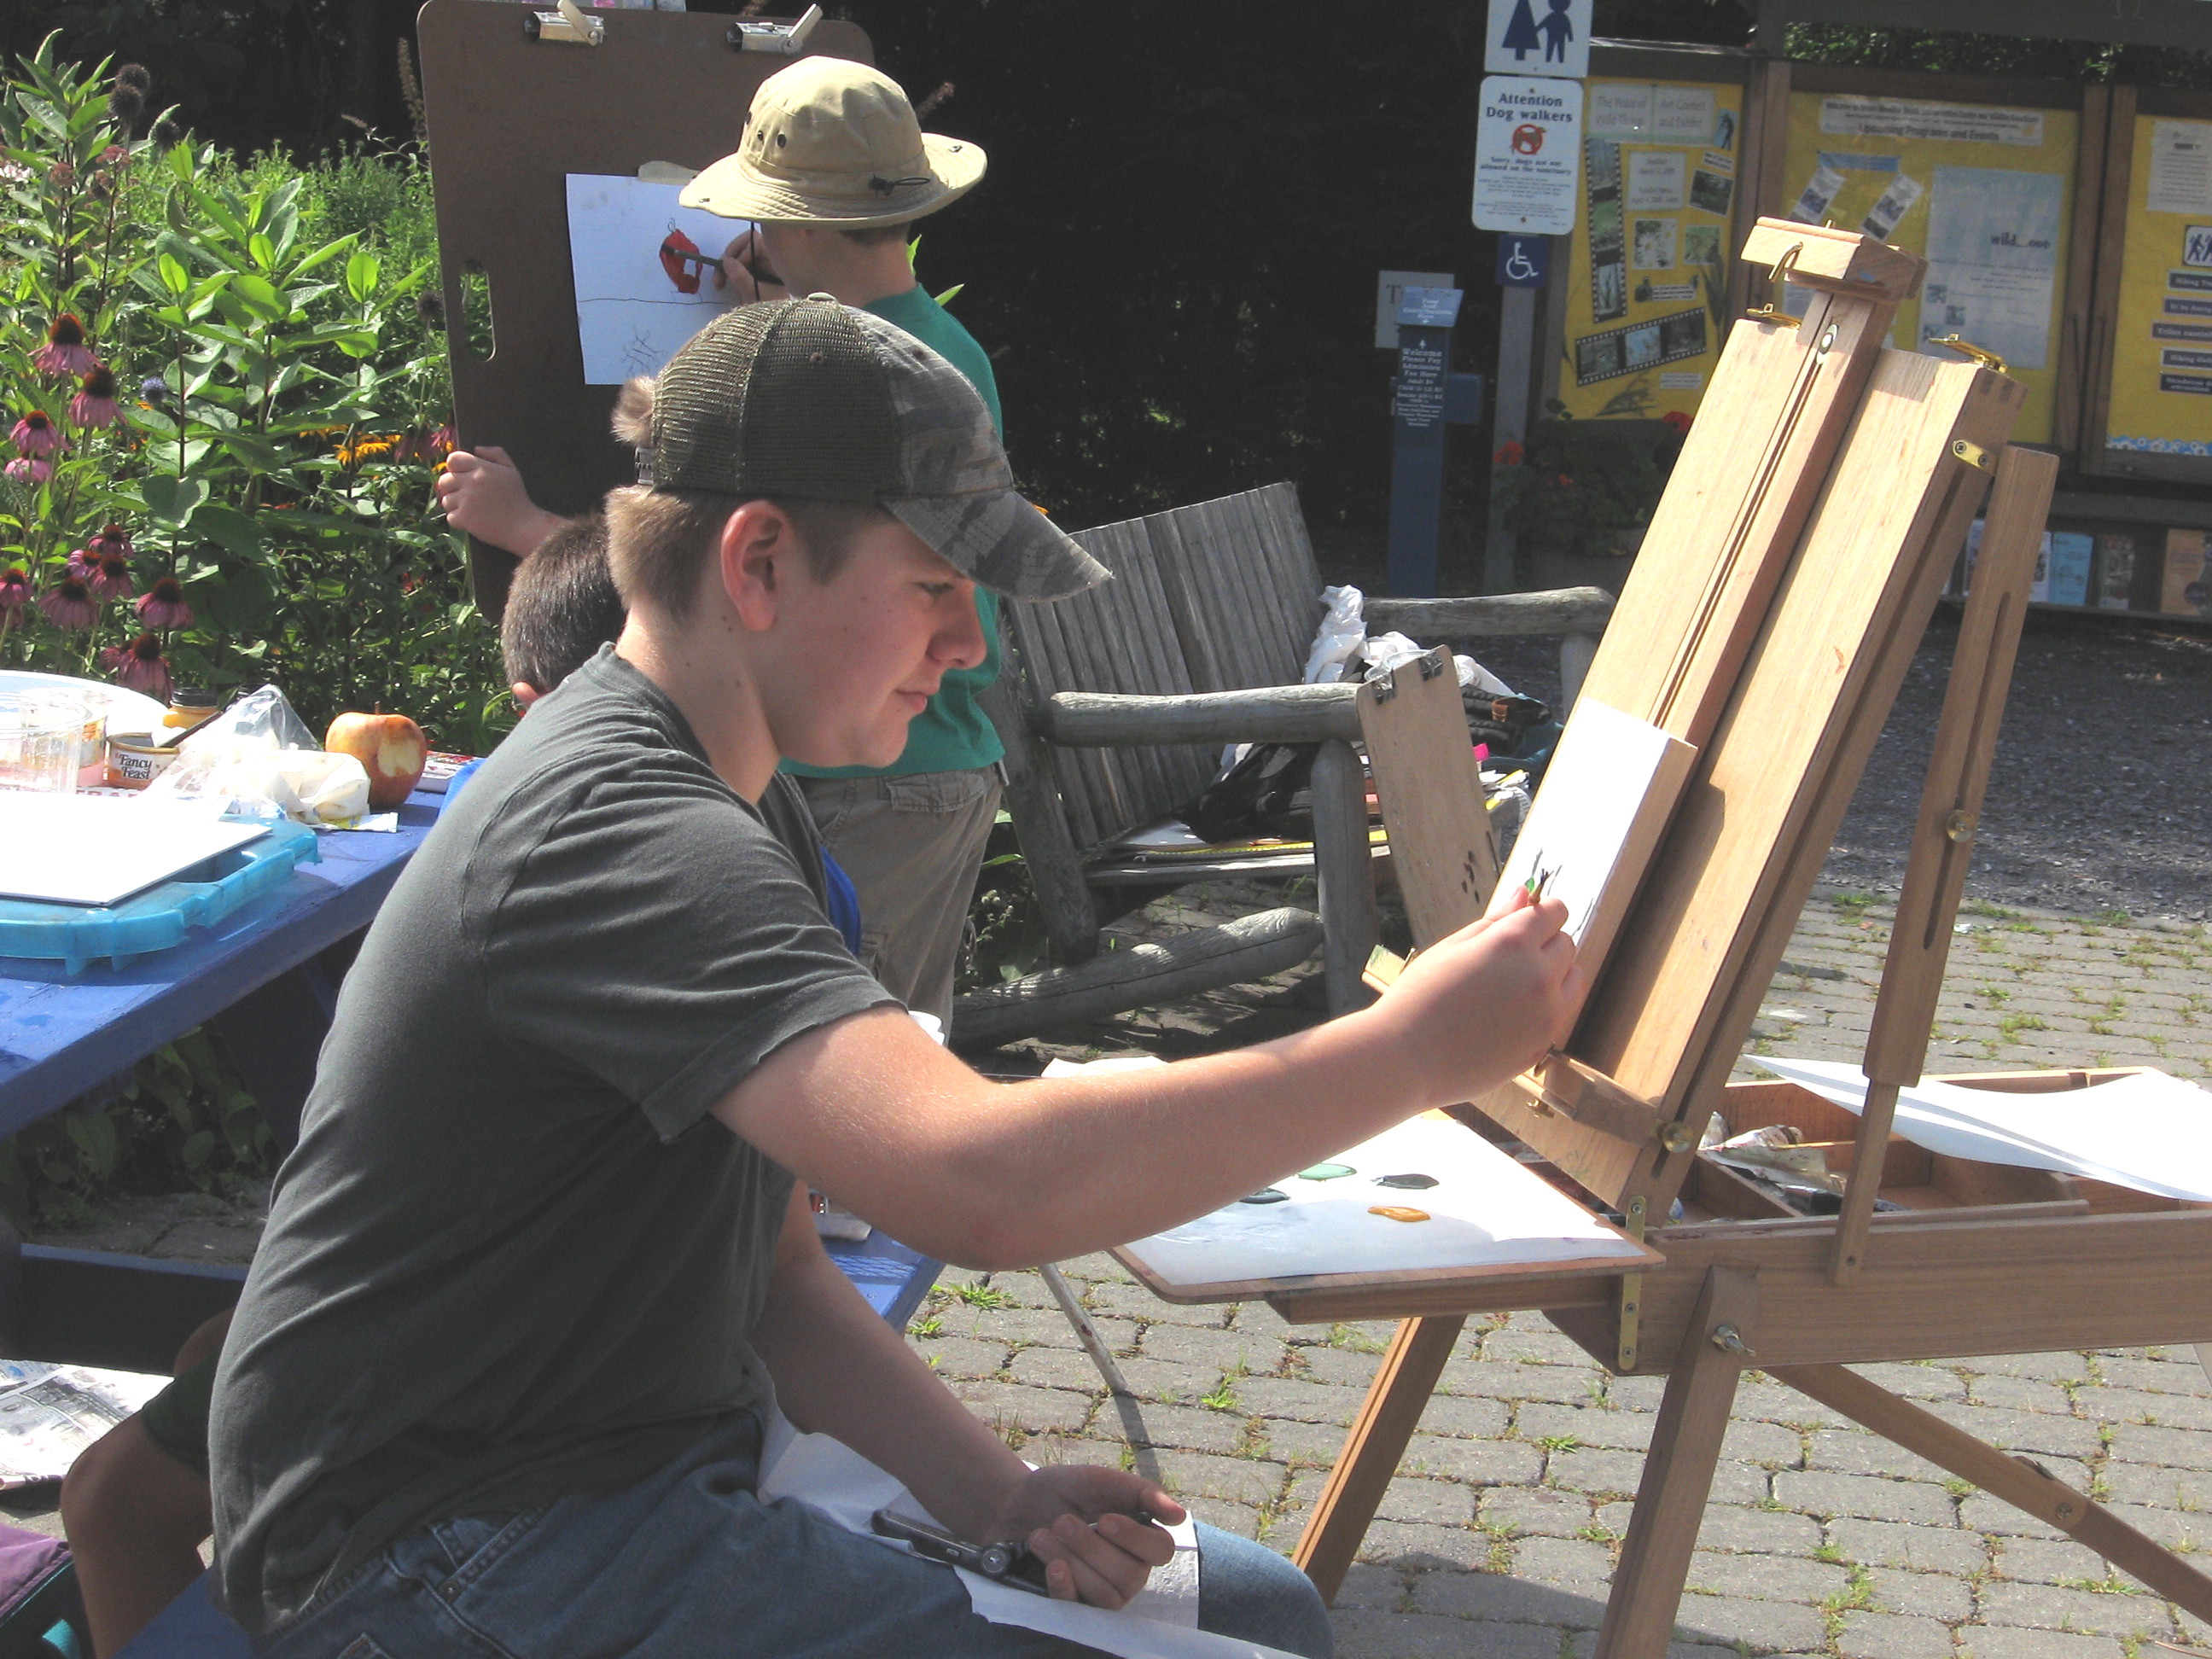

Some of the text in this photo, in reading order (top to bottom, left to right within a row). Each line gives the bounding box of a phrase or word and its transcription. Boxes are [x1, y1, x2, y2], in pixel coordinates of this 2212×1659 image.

[1499, 93, 1562, 107] Attention
[1486, 107, 1573, 122] Dog walkers
[1906, 125, 1948, 138] Programs
[1951, 130, 1968, 139] and
[1970, 129, 2000, 141] Events
[1401, 347, 1442, 357] Welcome
[120, 754, 152, 769] Fancy
[122, 766, 151, 780] Feast
